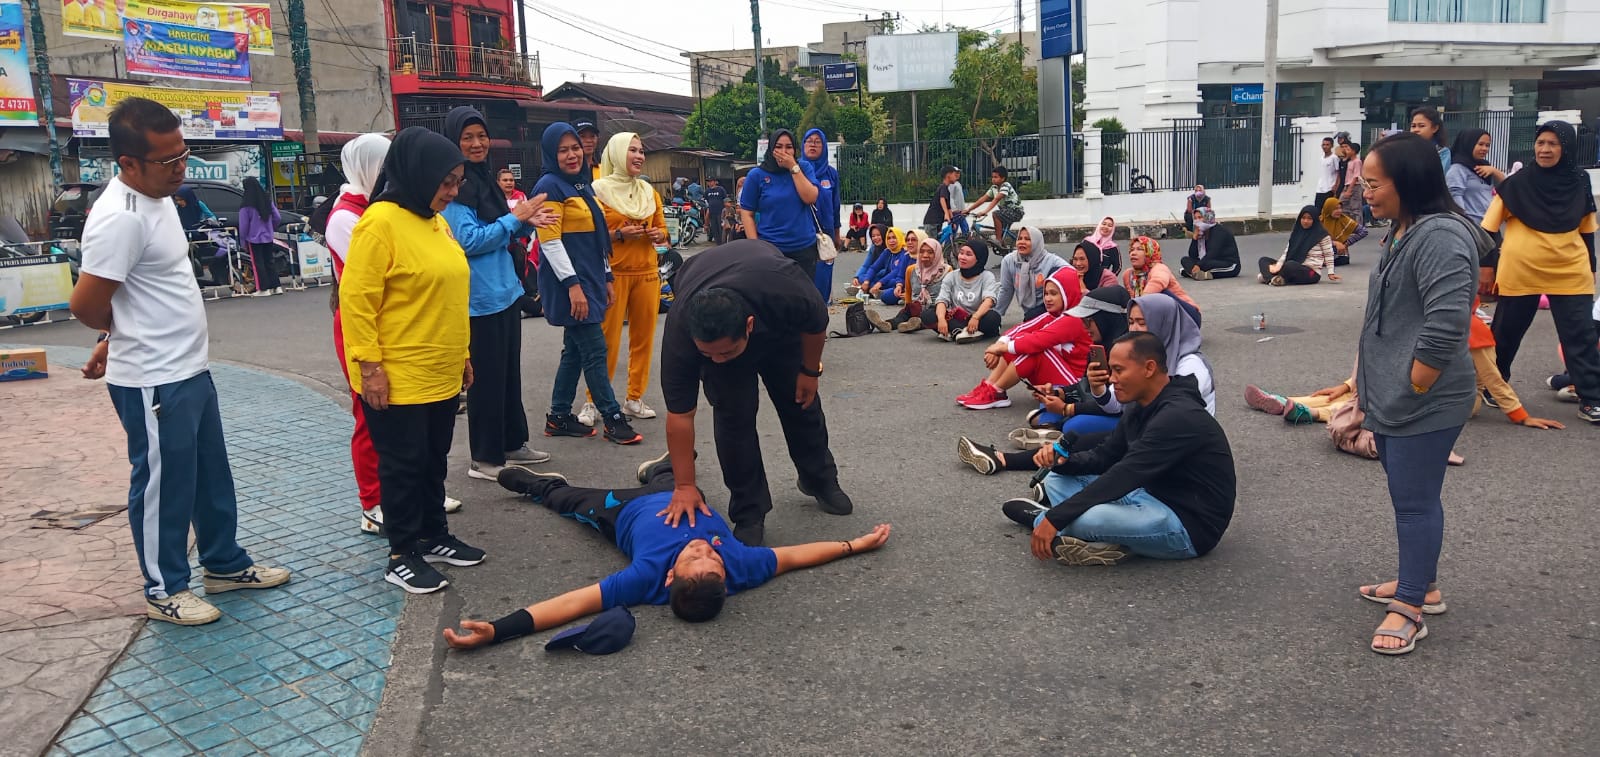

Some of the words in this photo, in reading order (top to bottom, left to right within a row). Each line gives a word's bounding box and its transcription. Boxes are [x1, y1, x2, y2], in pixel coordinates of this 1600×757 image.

[147, 6, 195, 21] Dirgahayu
[144, 40, 188, 56] MASIH
[189, 45, 237, 60] NYABU!
[152, 92, 199, 103] HARAPAN
[1234, 92, 1264, 101] e-Chann
[8, 100, 30, 111] 4737)
[186, 165, 223, 180] GAYO
